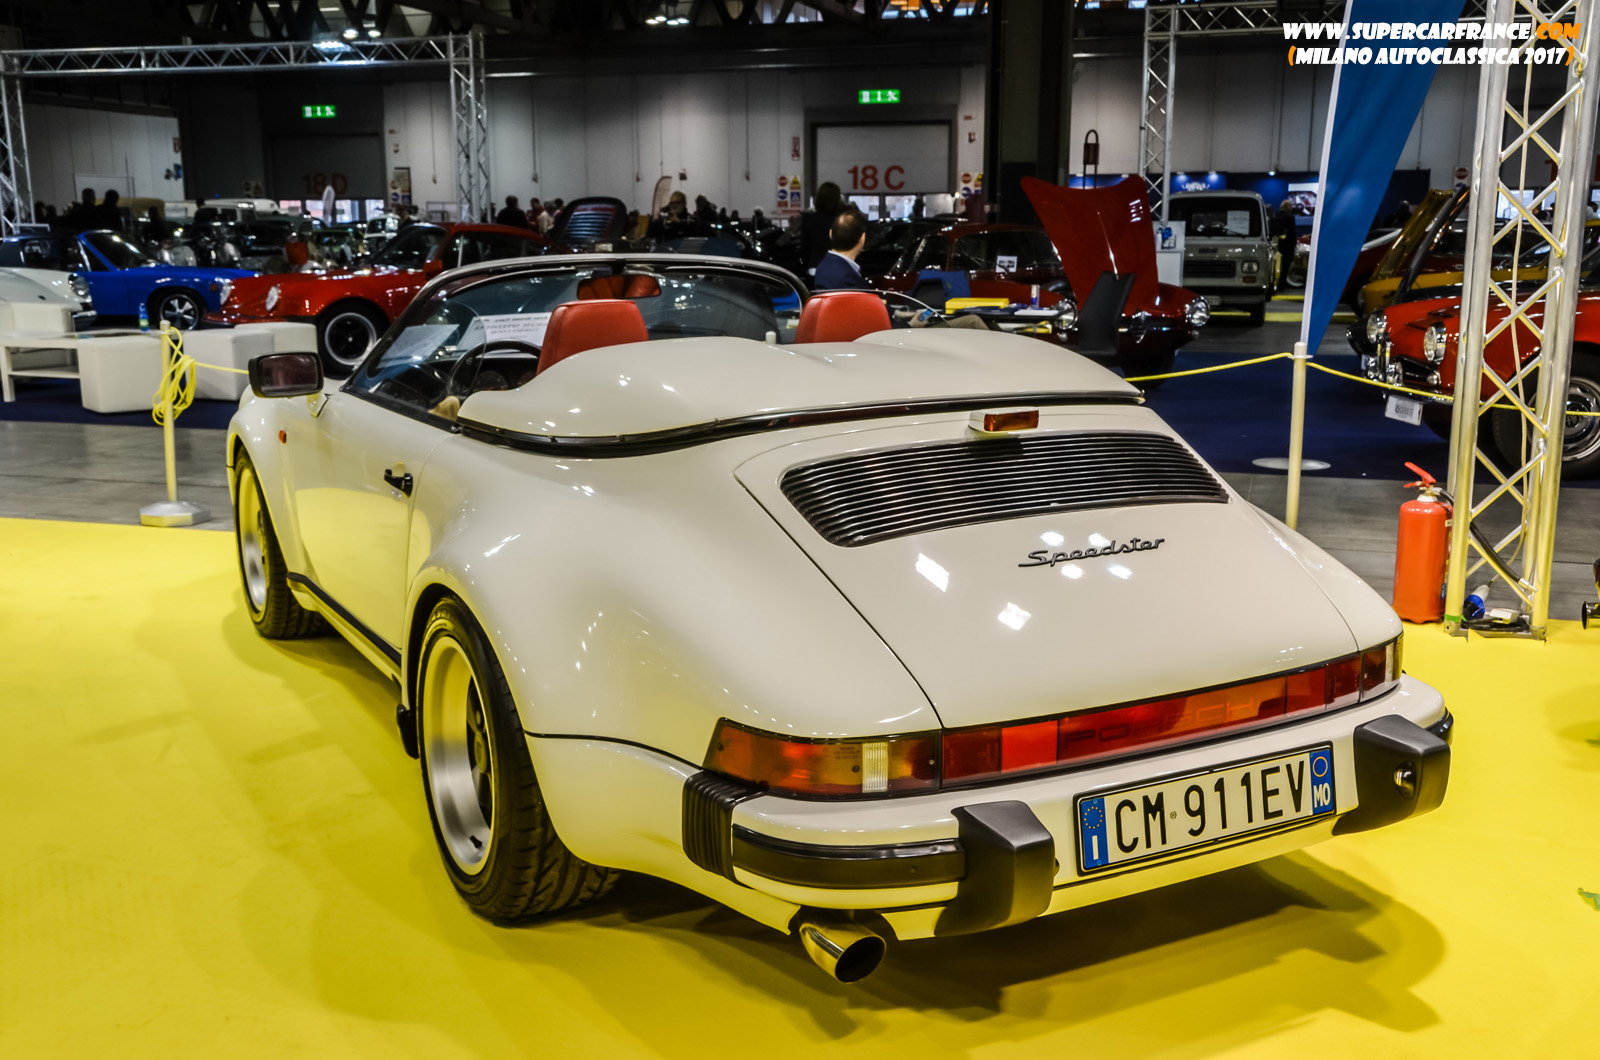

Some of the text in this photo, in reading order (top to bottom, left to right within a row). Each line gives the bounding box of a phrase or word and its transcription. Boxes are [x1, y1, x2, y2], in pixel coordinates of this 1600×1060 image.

[301, 172, 348, 194] 18 D
[847, 164, 905, 191] 18 C
[1018, 537, 1165, 567] Speedster
[1065, 696, 1284, 747] PORSCH
[1115, 791, 1167, 853] CM
[1184, 760, 1305, 837] 911EV
[1313, 782, 1331, 808] MO
